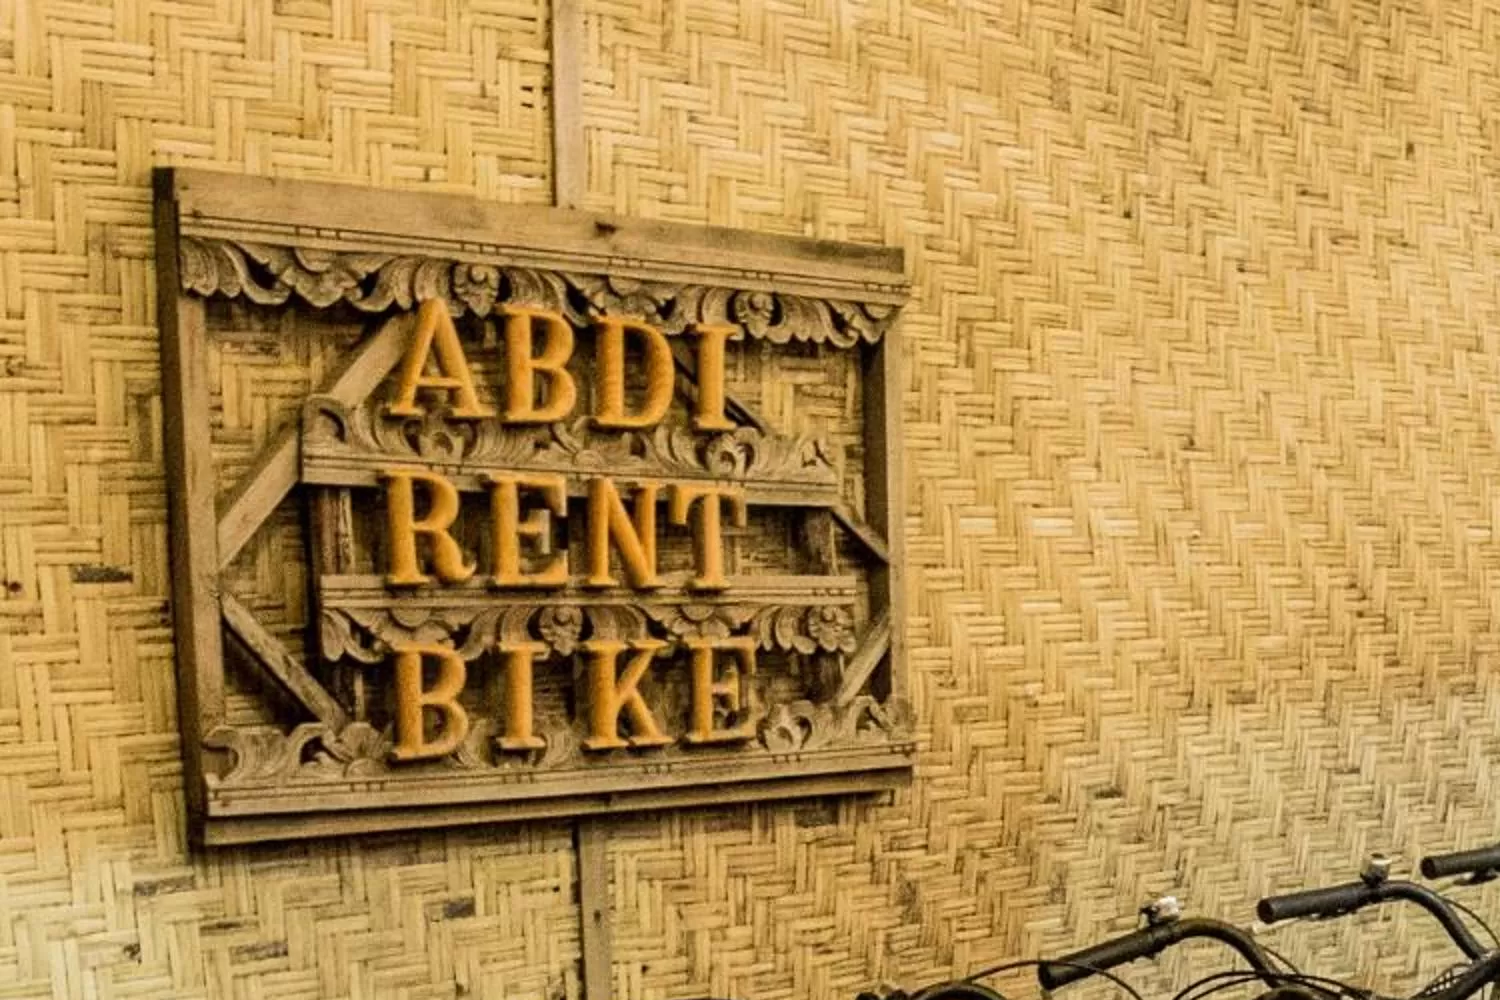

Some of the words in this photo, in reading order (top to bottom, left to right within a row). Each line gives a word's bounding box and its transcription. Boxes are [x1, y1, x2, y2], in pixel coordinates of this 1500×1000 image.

[384, 299, 742, 431] ABDI
[378, 466, 746, 590] RENT
[389, 636, 757, 761] BIKE
